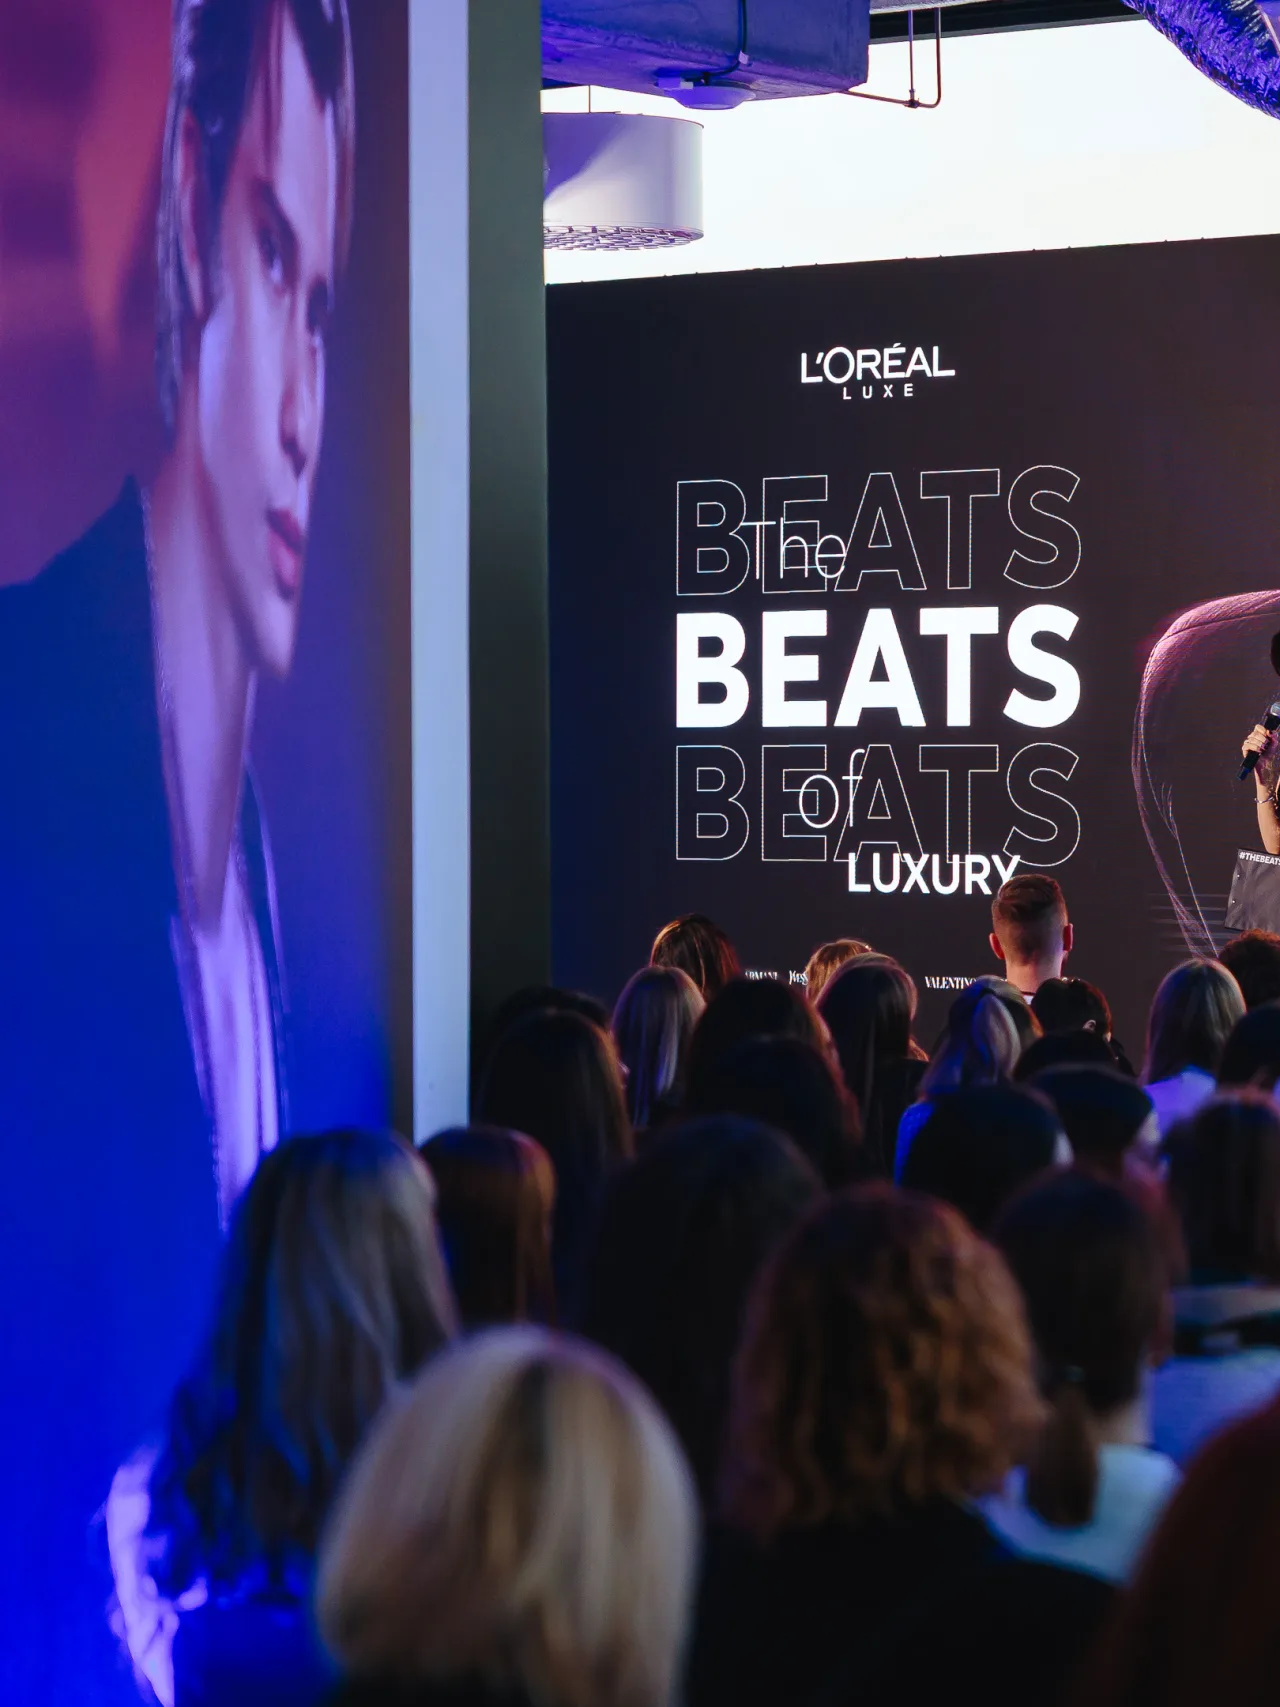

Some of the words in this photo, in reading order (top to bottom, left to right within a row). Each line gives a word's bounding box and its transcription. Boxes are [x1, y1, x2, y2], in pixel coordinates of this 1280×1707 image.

[800, 343, 955, 384] L'ORÉAL
[842, 383, 915, 400] LUXE
[676, 464, 1082, 596] BEATS
[741, 517, 847, 579] The
[675, 602, 1082, 729] BEATS
[675, 742, 1081, 867] BEATS
[799, 748, 866, 829] of
[847, 852, 1021, 895] LUXURY
